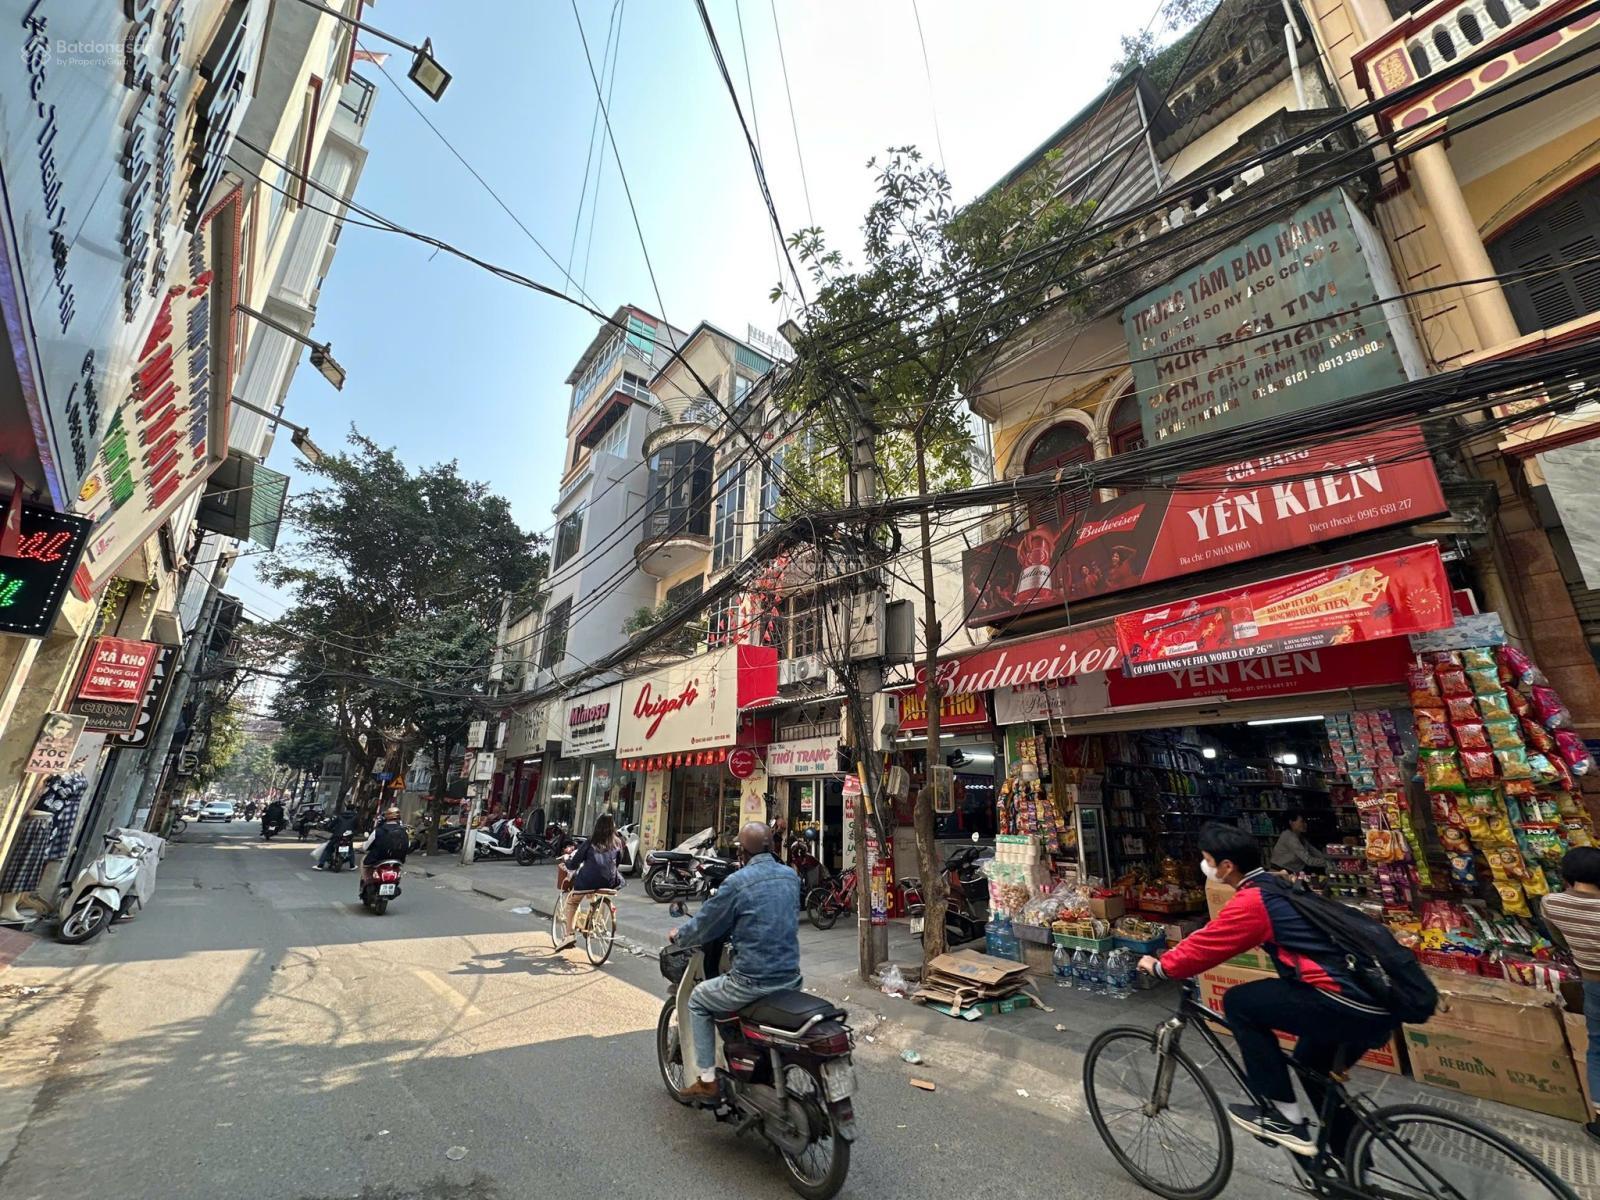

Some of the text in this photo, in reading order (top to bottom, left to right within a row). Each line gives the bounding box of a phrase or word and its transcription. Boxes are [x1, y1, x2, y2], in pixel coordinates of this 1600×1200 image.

[1131, 208, 1337, 335] TRUNG TÂM BẢO HÀNH
[1224, 291, 1243, 309] NY
[1247, 278, 1276, 300] ASC
[1329, 240, 1340, 255] 2
[1280, 280, 1337, 317] TIVI
[1254, 354, 1296, 382] HÀNH
[1318, 354, 1344, 374] 0913
[1187, 454, 1384, 542] YẾN KIÊN
[1077, 513, 1141, 541] Budweiser
[1308, 498, 1413, 534] Điện thoại: 0915 681 217
[96, 664, 140, 678] ĐỒNG GIÁ
[98, 648, 147, 666] XẢ KHO
[915, 643, 1120, 698] Budweiser
[1133, 664, 1142, 675] CƠ
[1142, 662, 1156, 674] HỘI
[1182, 656, 1193, 667] VÉ
[1193, 653, 1209, 665] FIFA
[1209, 649, 1238, 663] WORLD
[1238, 646, 1255, 659] CUP
[569, 702, 611, 727] Mimosa
[31, 758, 65, 769] NAM
[771, 748, 795, 765] THỜI
[796, 747, 834, 763] TRANG
[1439, 1055, 1497, 1079] REBORN
